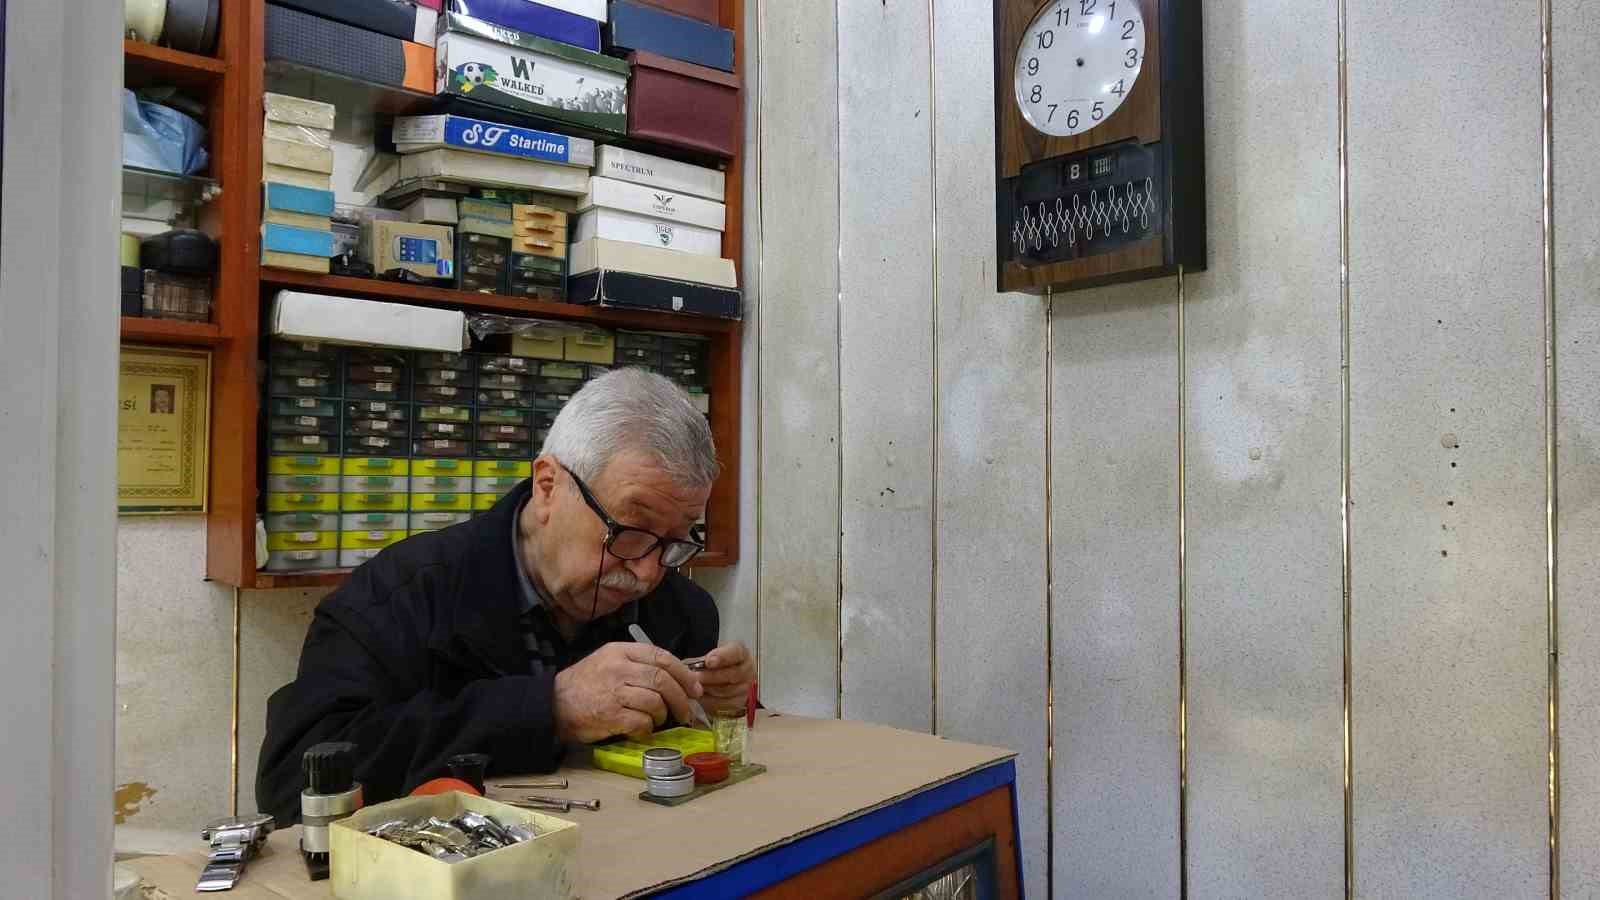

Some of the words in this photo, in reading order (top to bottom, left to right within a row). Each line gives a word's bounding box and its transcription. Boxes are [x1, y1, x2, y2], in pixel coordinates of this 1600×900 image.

[1056, 8, 1070, 26] 11
[1080, 0, 1096, 16] 12
[1108, 1, 1116, 20] 1
[1036, 30, 1054, 49] 10
[1121, 20, 1135, 40] 2
[1028, 57, 1040, 76] 9
[1124, 48, 1138, 68] 3
[501, 77, 544, 96] WALKED
[1030, 85, 1042, 103] 8
[1111, 79, 1125, 97] 4
[1047, 104, 1058, 123] 7
[1067, 110, 1080, 129] 6
[1091, 102, 1104, 121] 5
[509, 134, 565, 154] Startime
[609, 160, 654, 177] SPECTRUM
